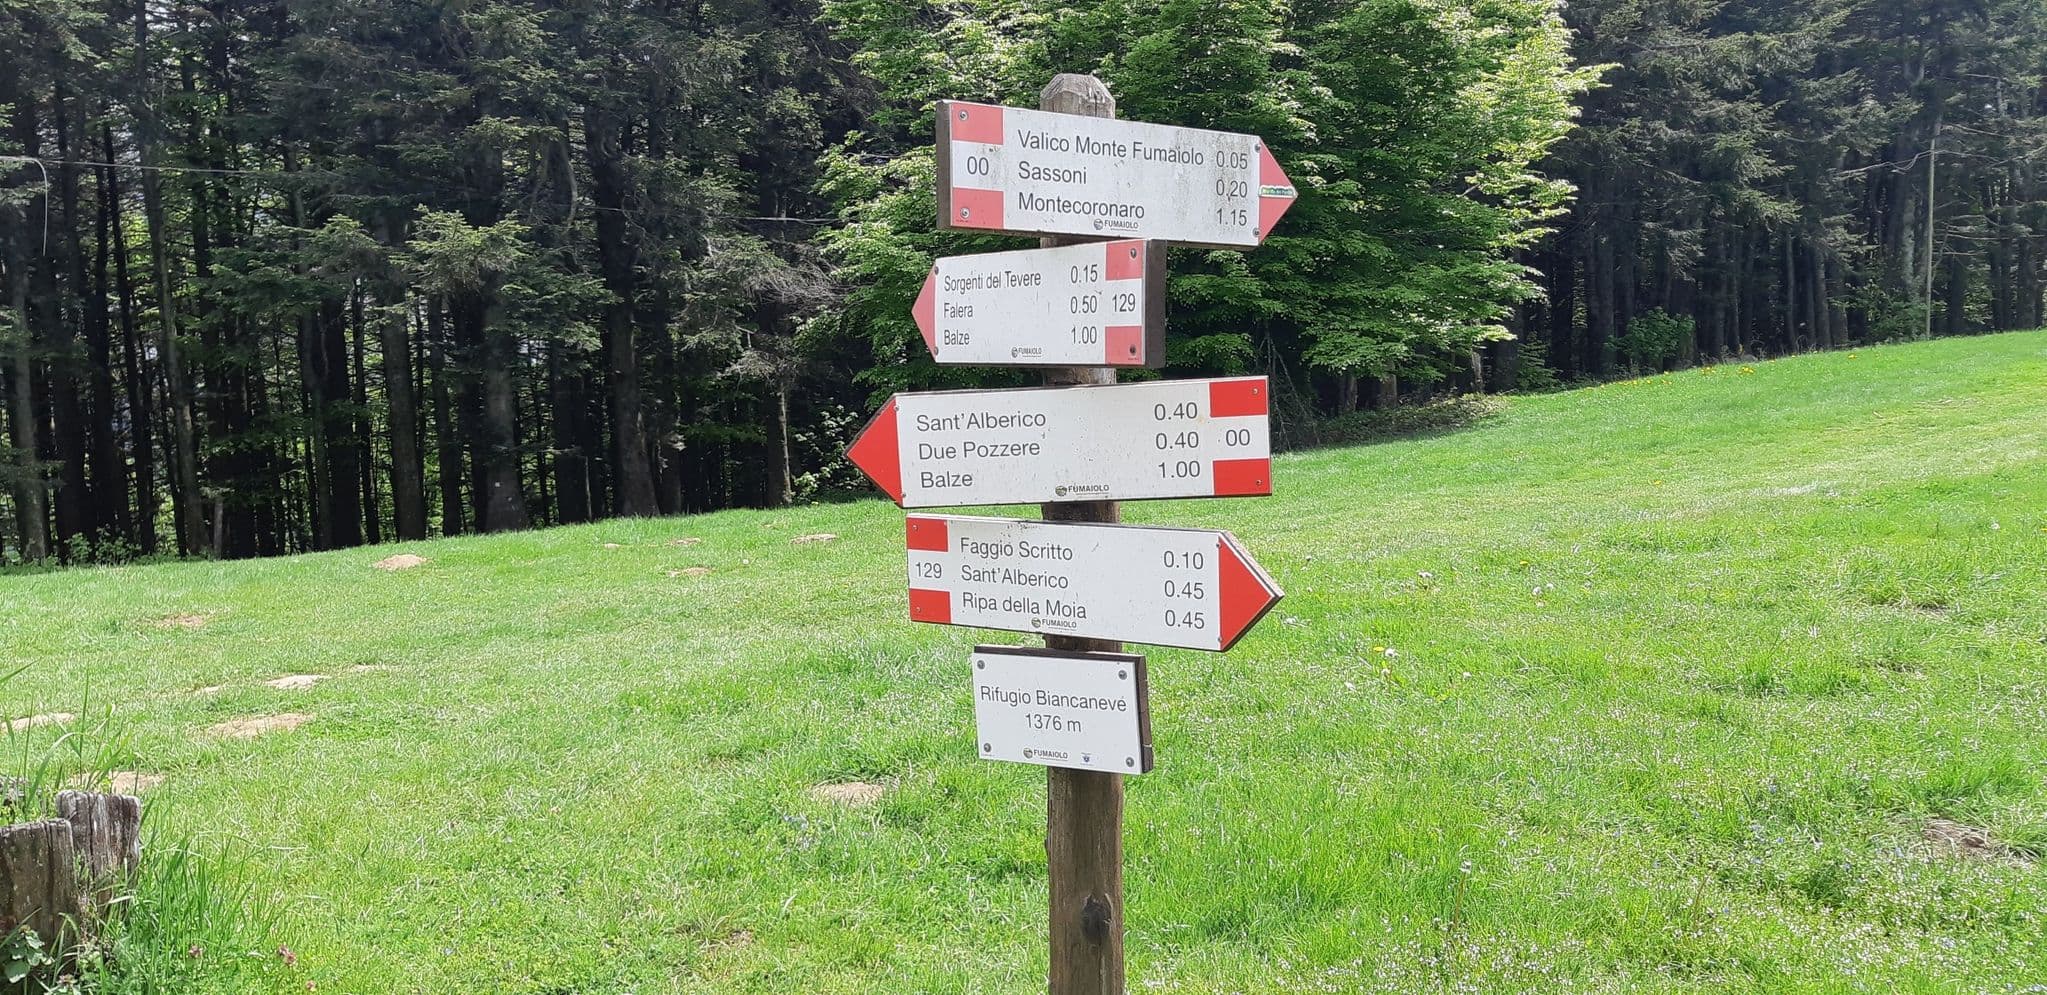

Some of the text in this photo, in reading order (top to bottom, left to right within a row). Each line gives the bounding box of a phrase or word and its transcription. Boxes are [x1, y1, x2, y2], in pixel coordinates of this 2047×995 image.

[1018, 129, 1248, 170] Valico Monte Fumaiolo 0.05
[966, 155, 990, 176] 00
[1018, 160, 1087, 185] Sassoni
[1216, 179, 1248, 198] 0.20
[1018, 191, 1247, 226] Montecoronaro 1.15
[944, 264, 1098, 295] Sorgenti del Tevere 0.15
[944, 293, 1136, 319] Falera 0.50 129
[944, 326, 1097, 346] Balze 1.00
[916, 402, 1198, 433] Sant'Alberico 0.40
[919, 428, 1250, 460] Due Pozzere 0.40 00
[921, 460, 1200, 488] Balze 1.00
[1068, 484, 1110, 492] FUMAIOLO
[960, 537, 1204, 570] Faggio Scritto 0.10
[916, 562, 942, 579] 129
[962, 564, 1204, 600] Sant'Alberico 0.45
[962, 591, 1205, 629] Ripa della Moia 0.45
[1042, 618, 1077, 628] FUMAIOLO
[980, 686, 1031, 707] Rifugio
[1026, 714, 1082, 732] 1376 m
[1034, 750, 1068, 759] FUMAIOLO
